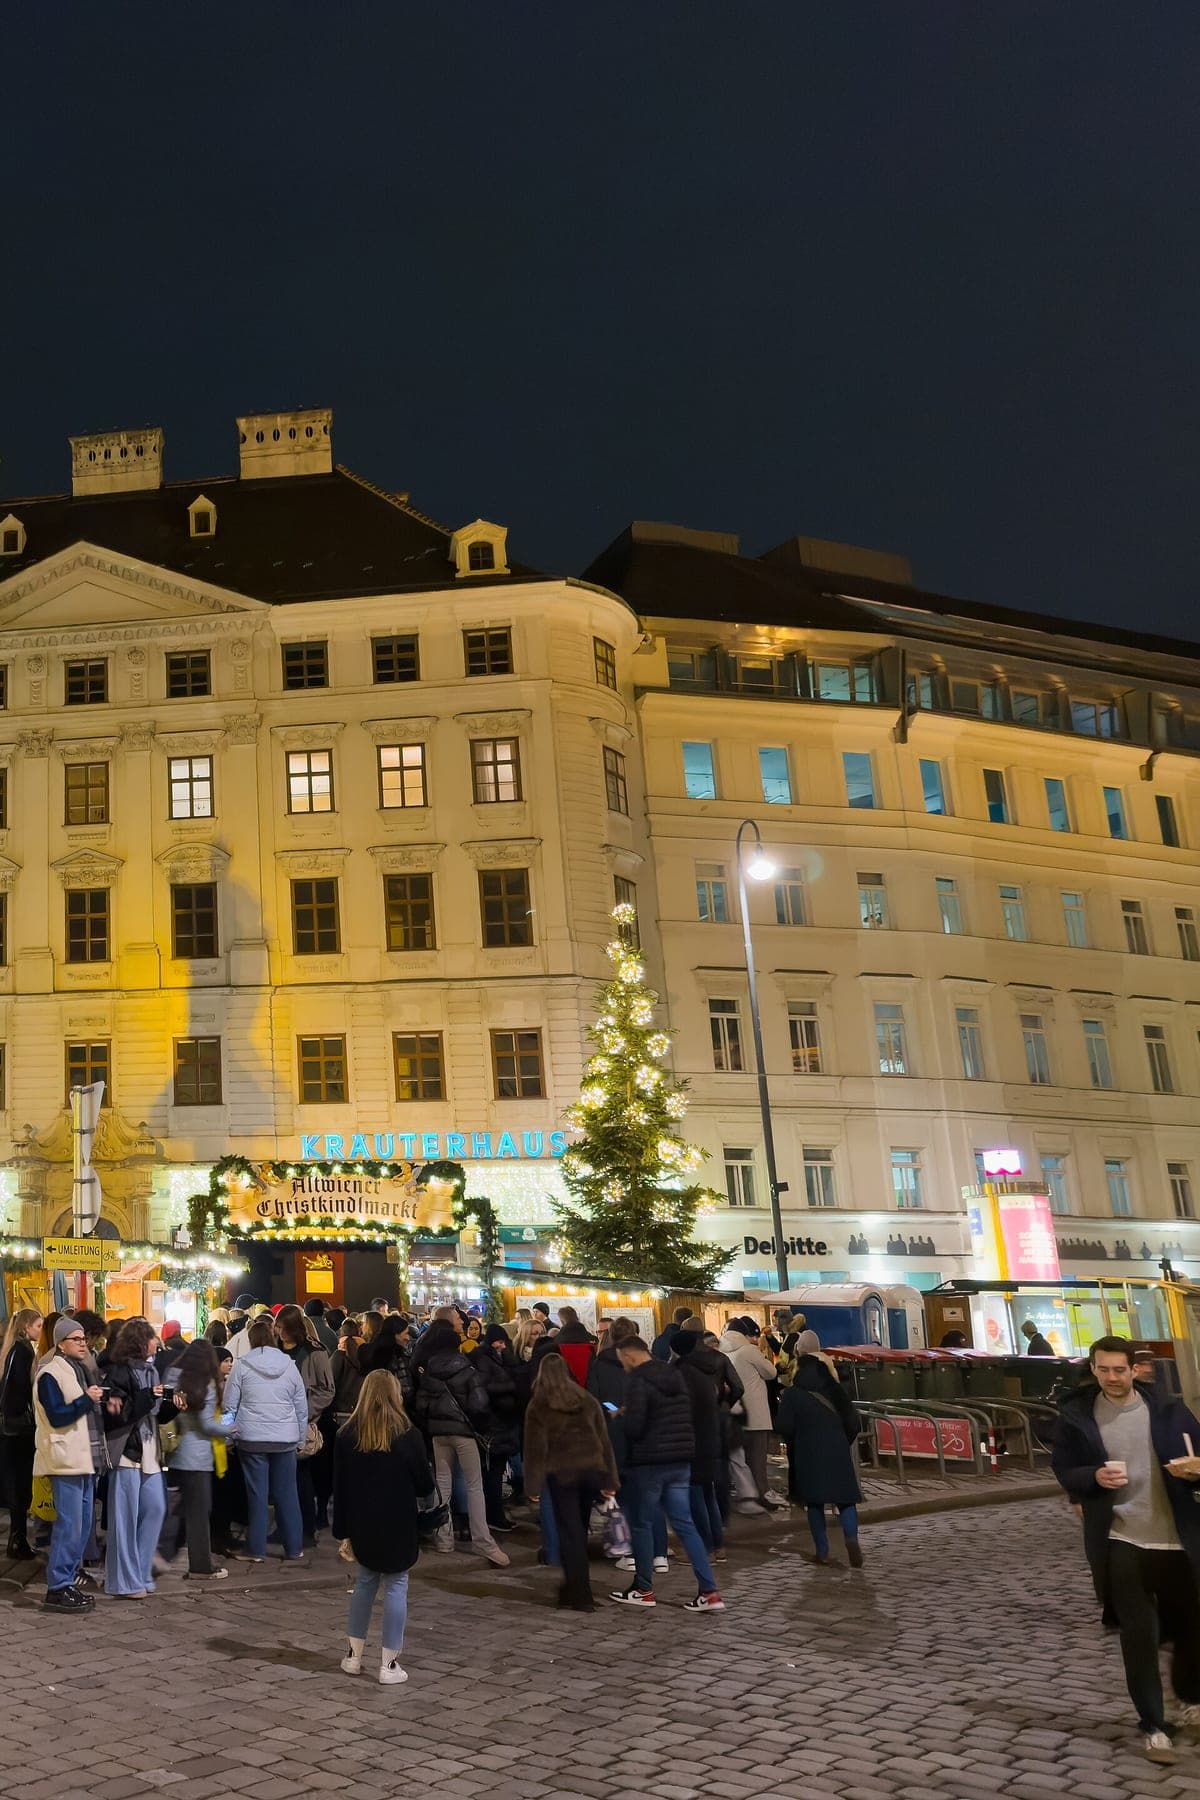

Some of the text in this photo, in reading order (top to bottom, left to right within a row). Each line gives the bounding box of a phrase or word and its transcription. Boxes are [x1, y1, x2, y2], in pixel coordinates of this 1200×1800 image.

[301, 1131, 567, 1161] KRÄUTERHAUS
[290, 1175, 381, 1197] Altwiener
[256, 1194, 419, 1220] Christkindlmarkt
[58, 1245, 100, 1256] UMLEITUNG
